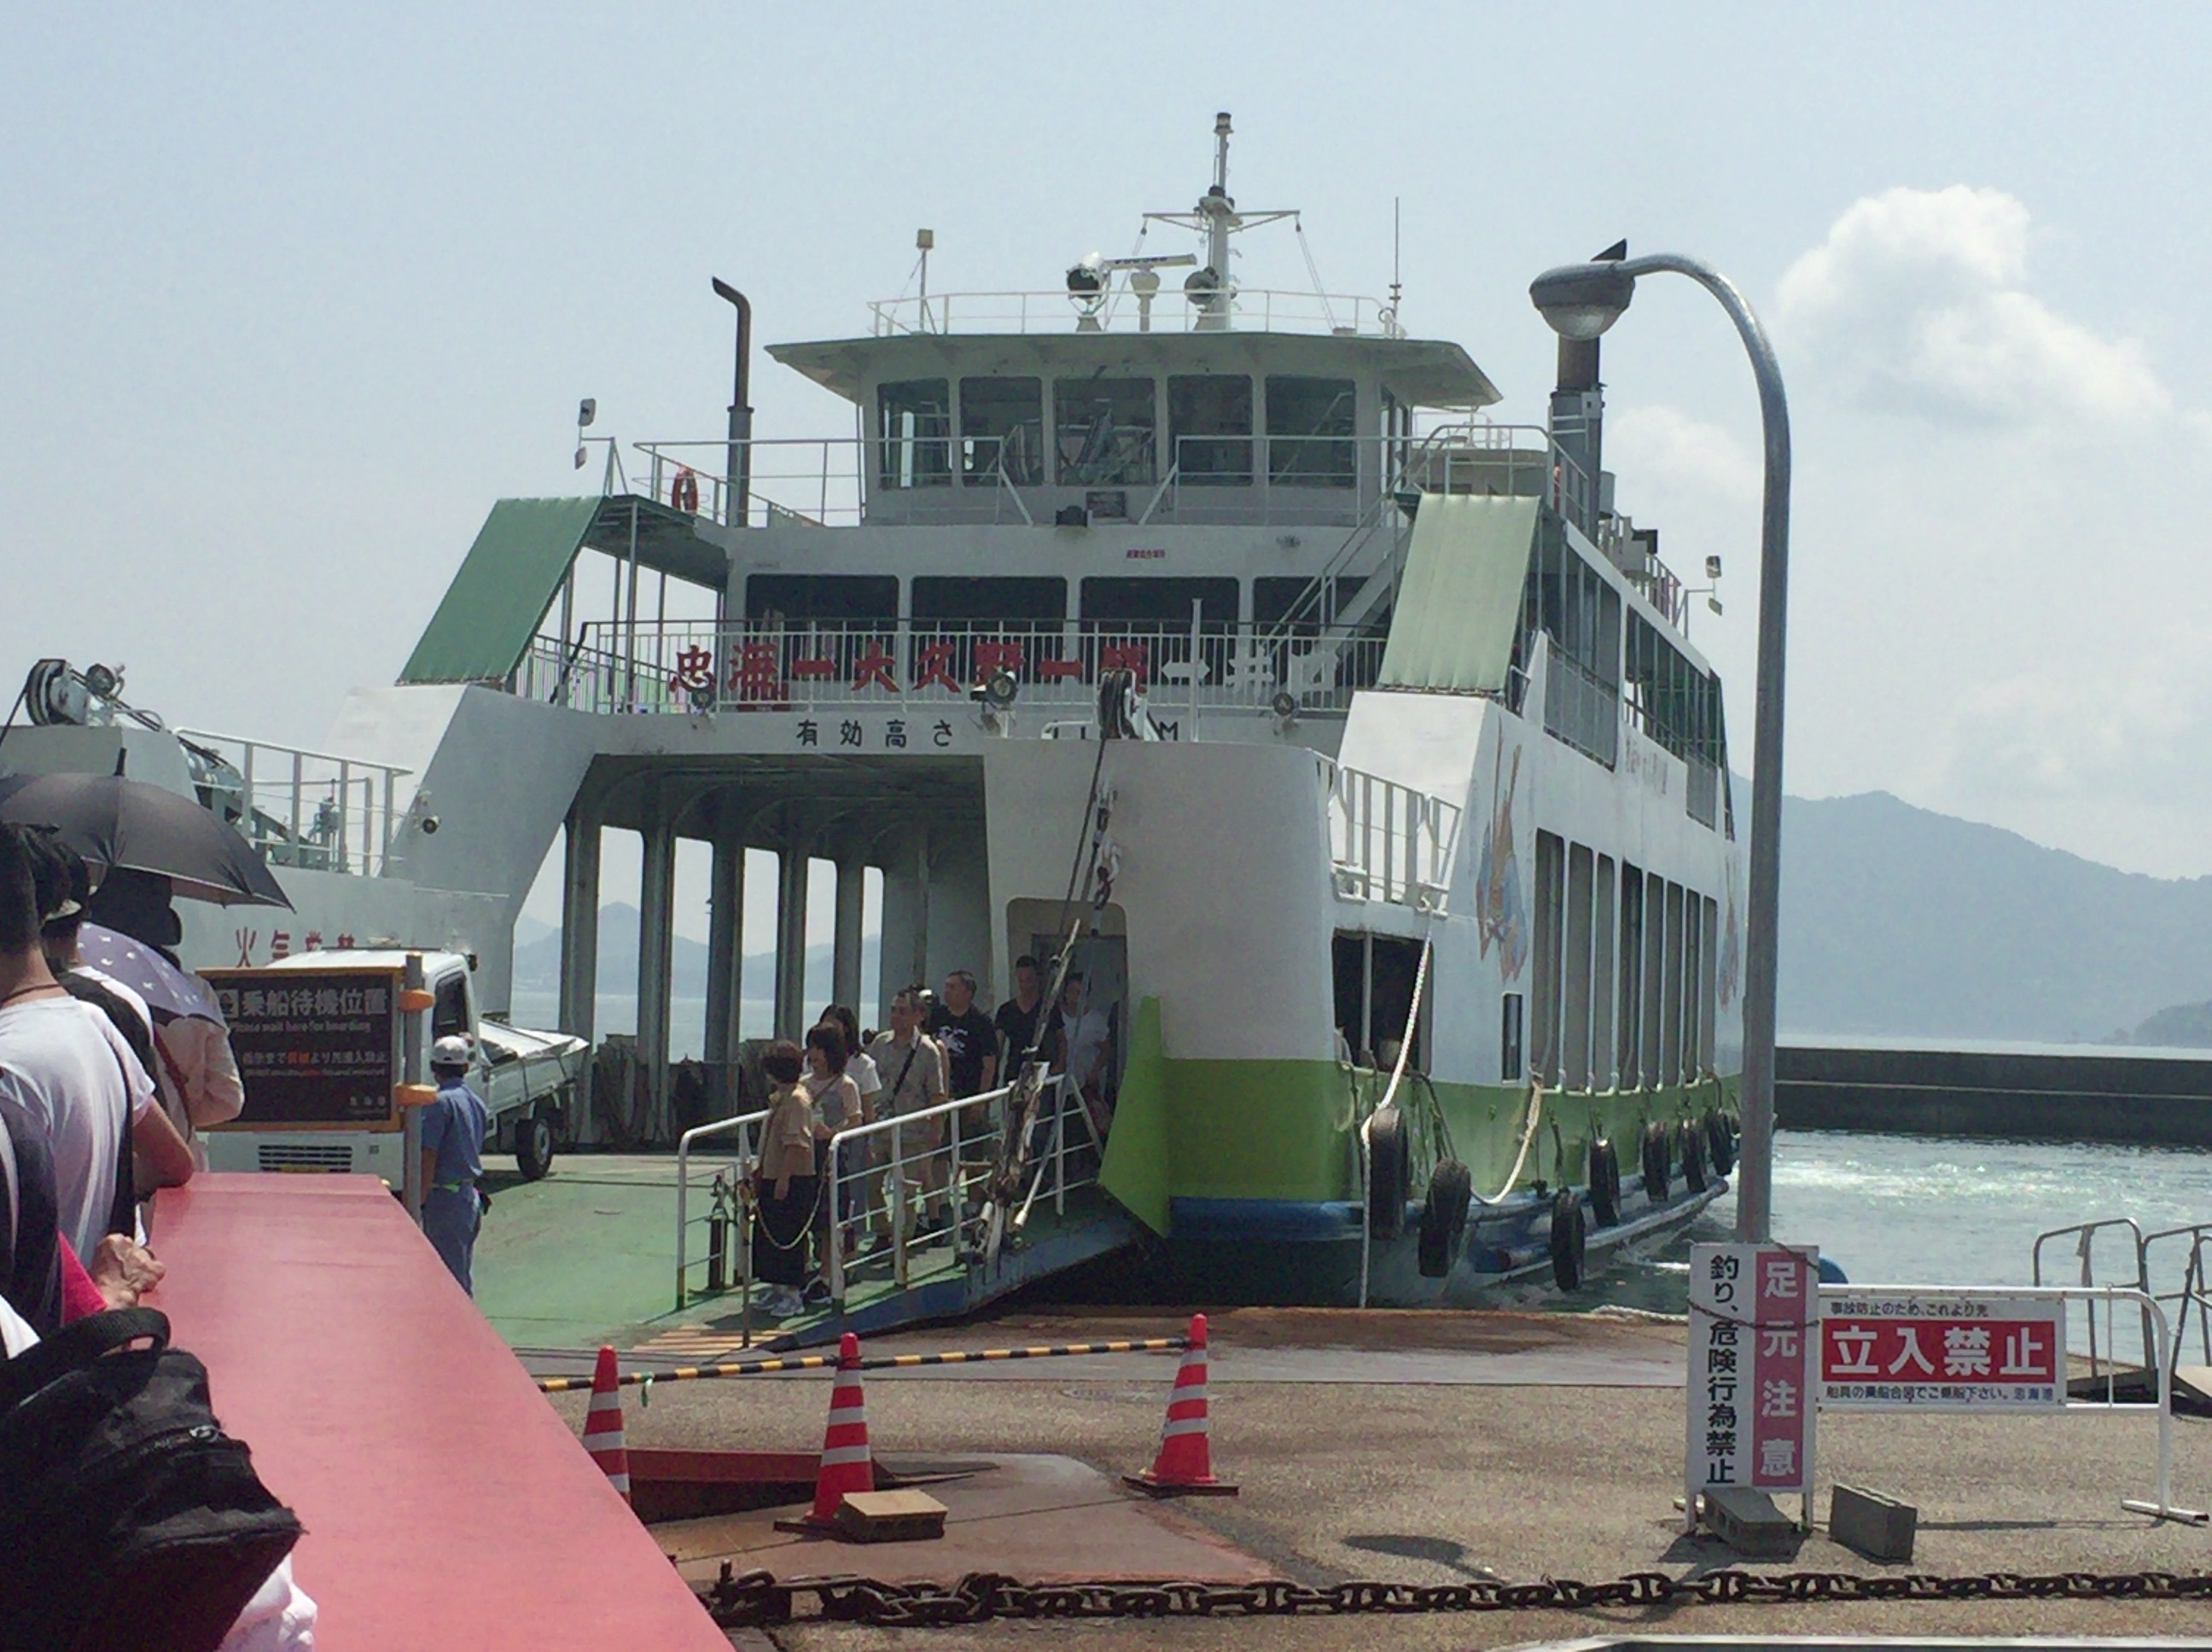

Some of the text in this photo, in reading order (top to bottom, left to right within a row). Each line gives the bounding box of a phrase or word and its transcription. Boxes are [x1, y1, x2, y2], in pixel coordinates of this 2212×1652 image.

[796, 718, 953, 747] 有効高さ
[242, 988, 387, 1016] 乗船待機位置
[1706, 1255, 1739, 1485] 釣り、危険行為禁止
[1760, 1261, 1798, 1477] 足元注意
[1830, 1324, 2047, 1376] 立入禁止
